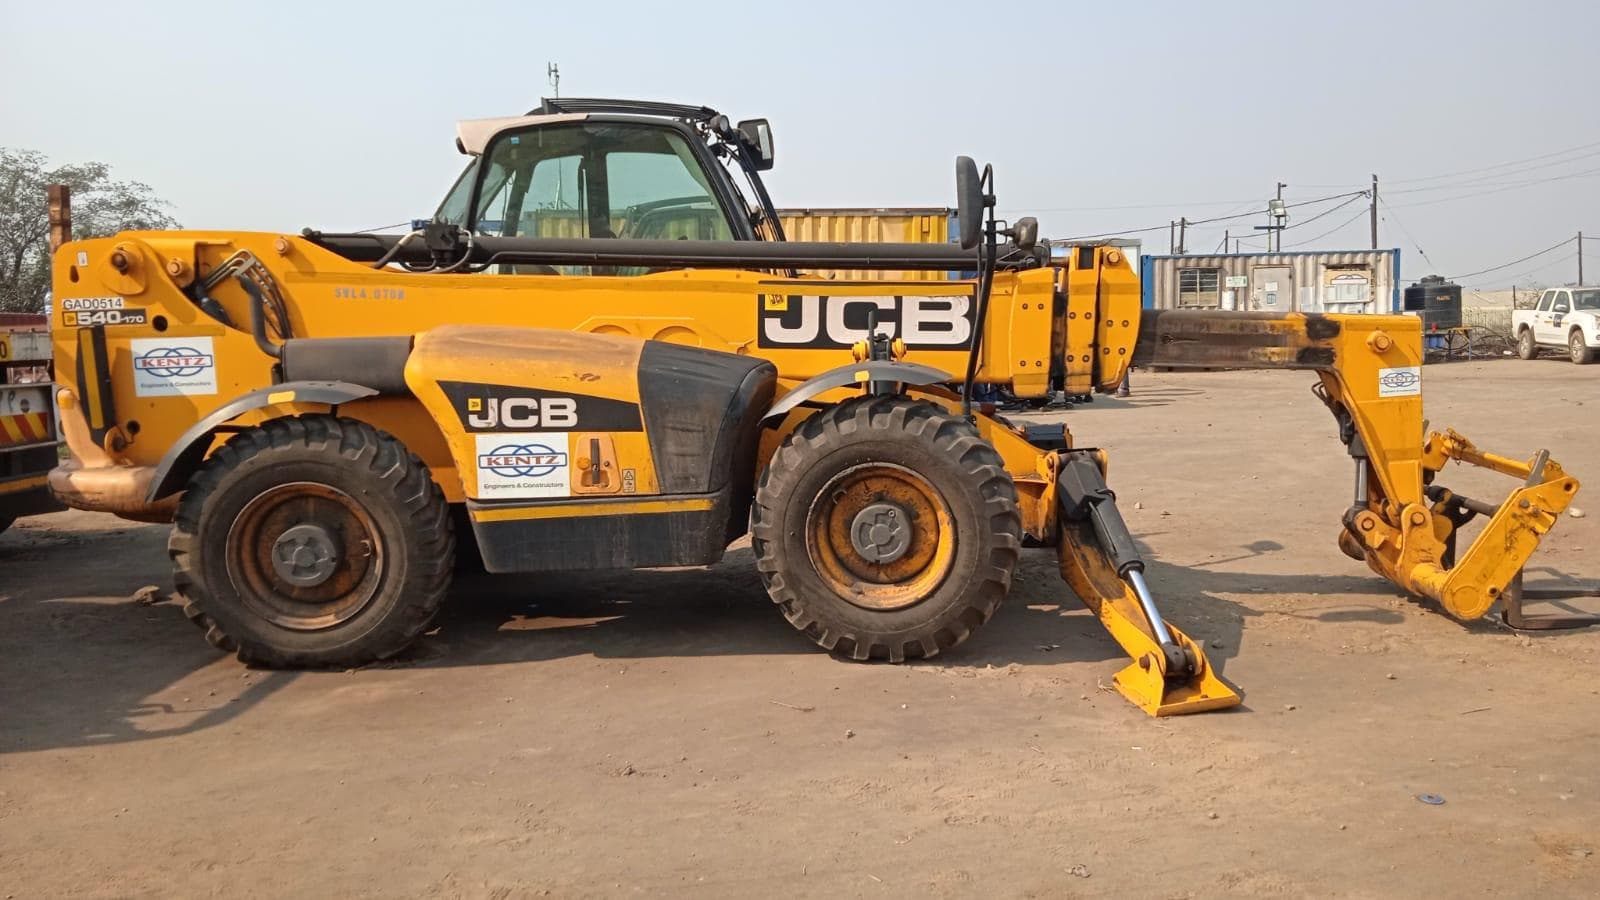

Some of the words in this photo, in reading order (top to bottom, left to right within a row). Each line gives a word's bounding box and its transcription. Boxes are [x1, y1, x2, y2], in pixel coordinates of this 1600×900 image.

[63, 298, 122, 310] GAD0514
[764, 295, 971, 345] JCB
[141, 357, 206, 368] KENTZ
[468, 397, 578, 428] JCB
[486, 455, 560, 466] KENTZ
